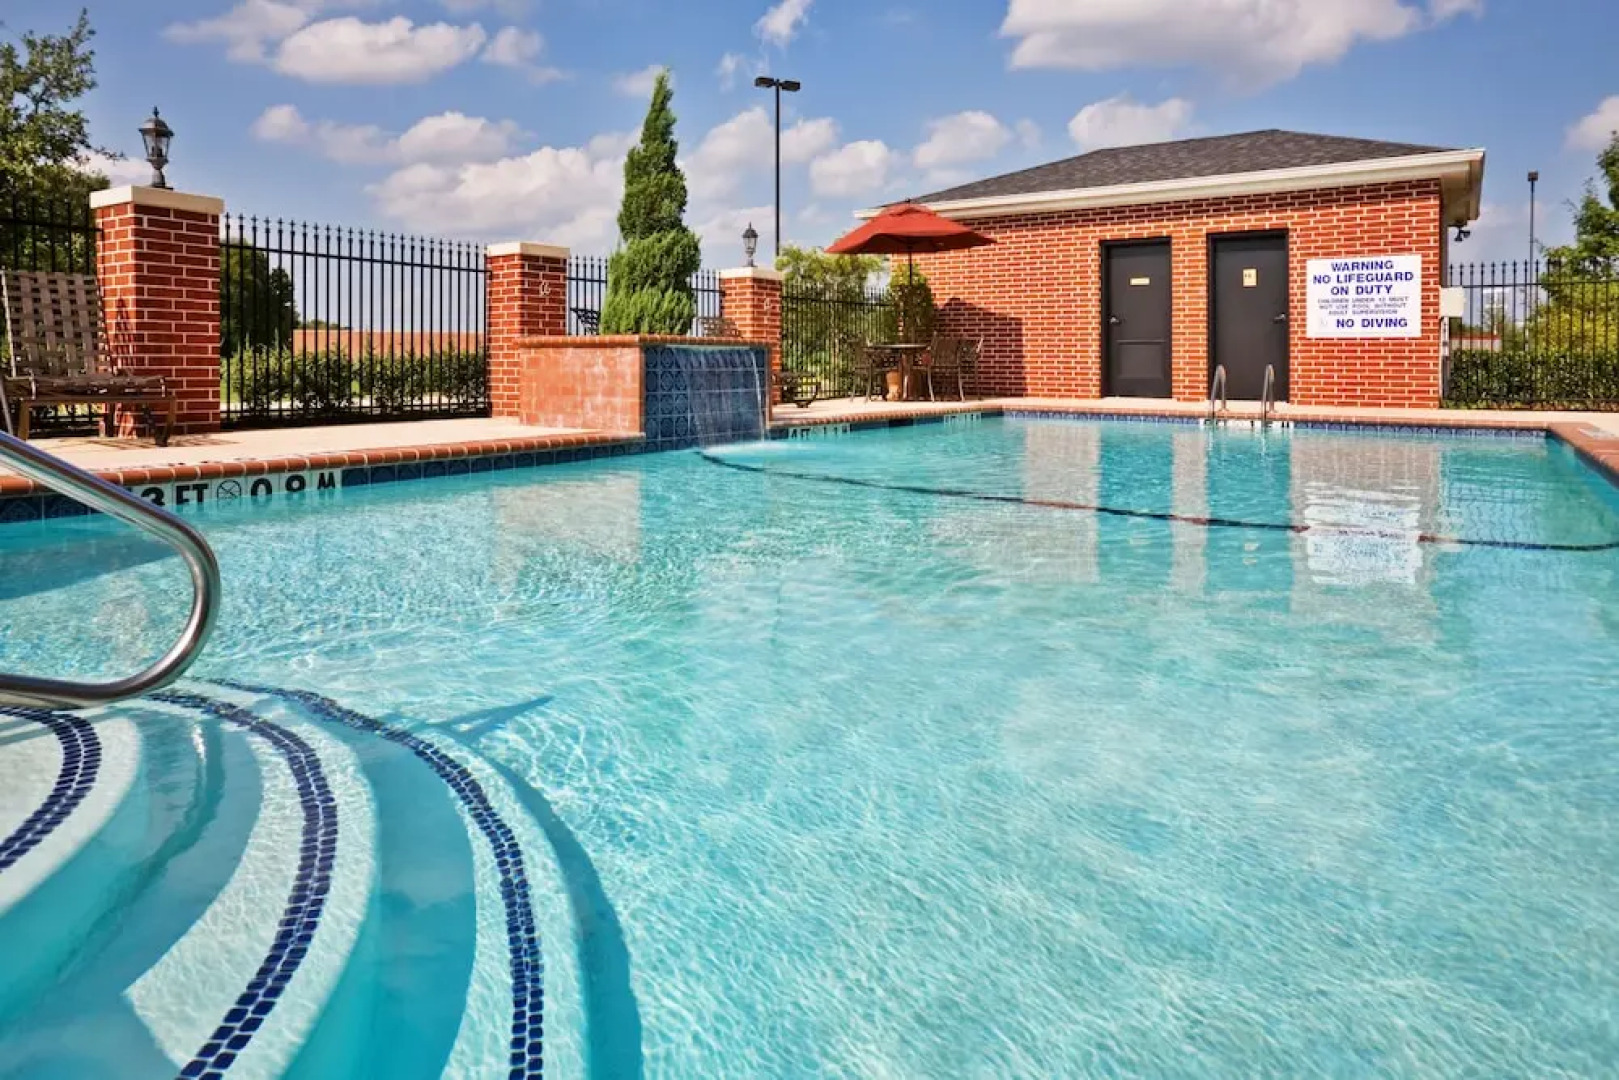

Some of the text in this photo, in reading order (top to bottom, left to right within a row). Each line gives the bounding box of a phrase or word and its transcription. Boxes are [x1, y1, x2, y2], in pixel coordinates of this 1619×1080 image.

[1331, 260, 1394, 272] WARNING
[1313, 271, 1414, 284] NO LIFEGUARD
[1331, 285, 1393, 295] ON DUTY
[1336, 317, 1408, 328] NO DIVING
[176, 483, 209, 505] FT
